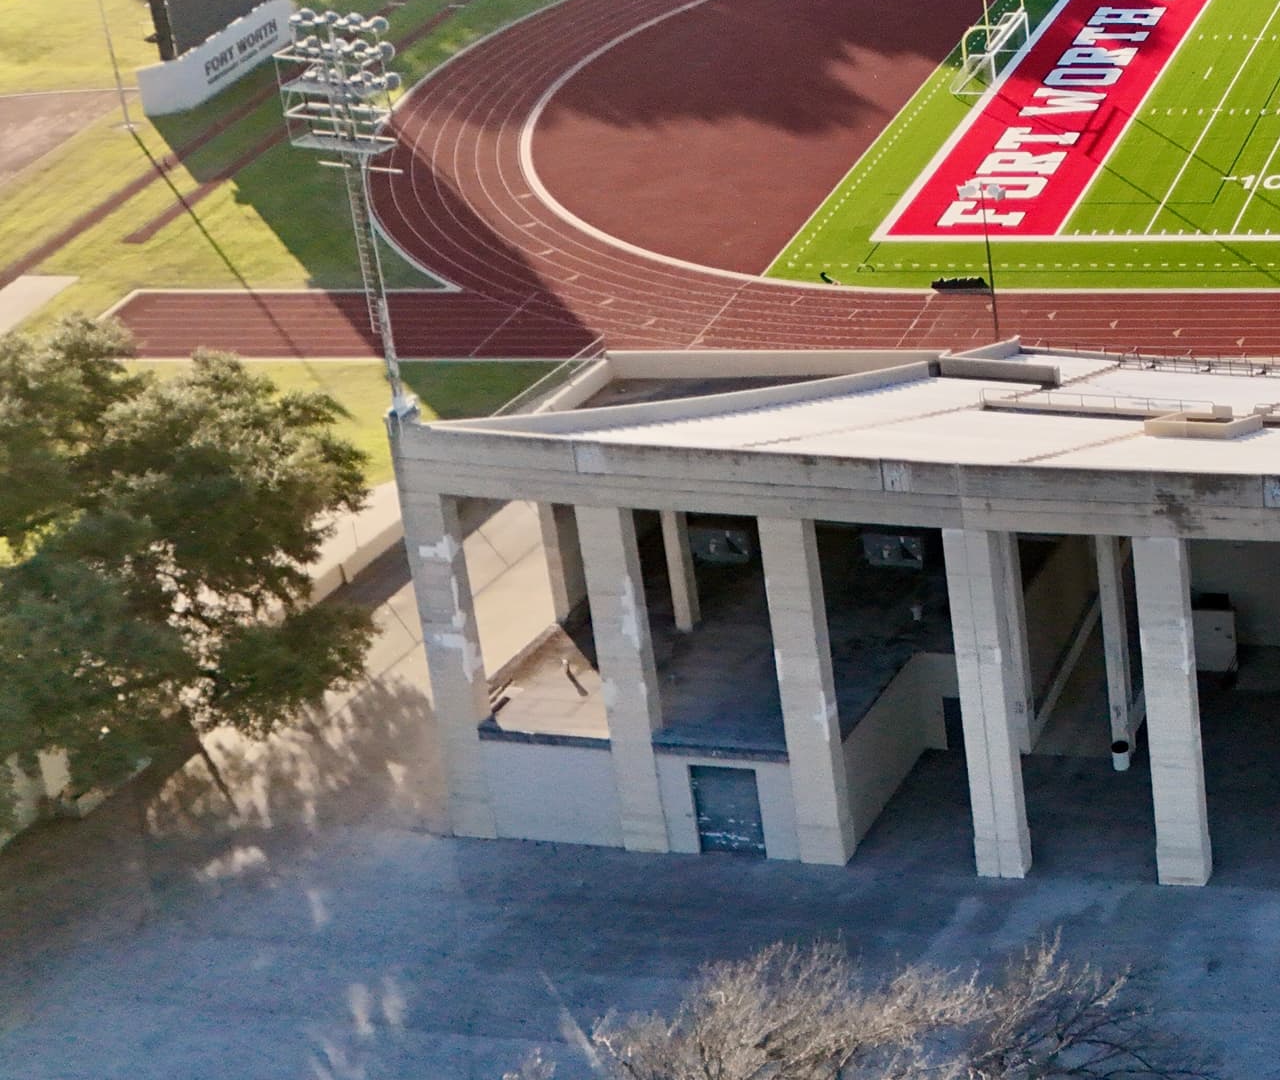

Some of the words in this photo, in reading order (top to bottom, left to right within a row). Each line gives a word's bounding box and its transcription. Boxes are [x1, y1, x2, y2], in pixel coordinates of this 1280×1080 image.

[204, 45, 235, 76] FORT
[236, 19, 278, 56] WORTH
[937, 126, 1080, 227] FORT
[1019, 6, 1166, 116] WORTH
